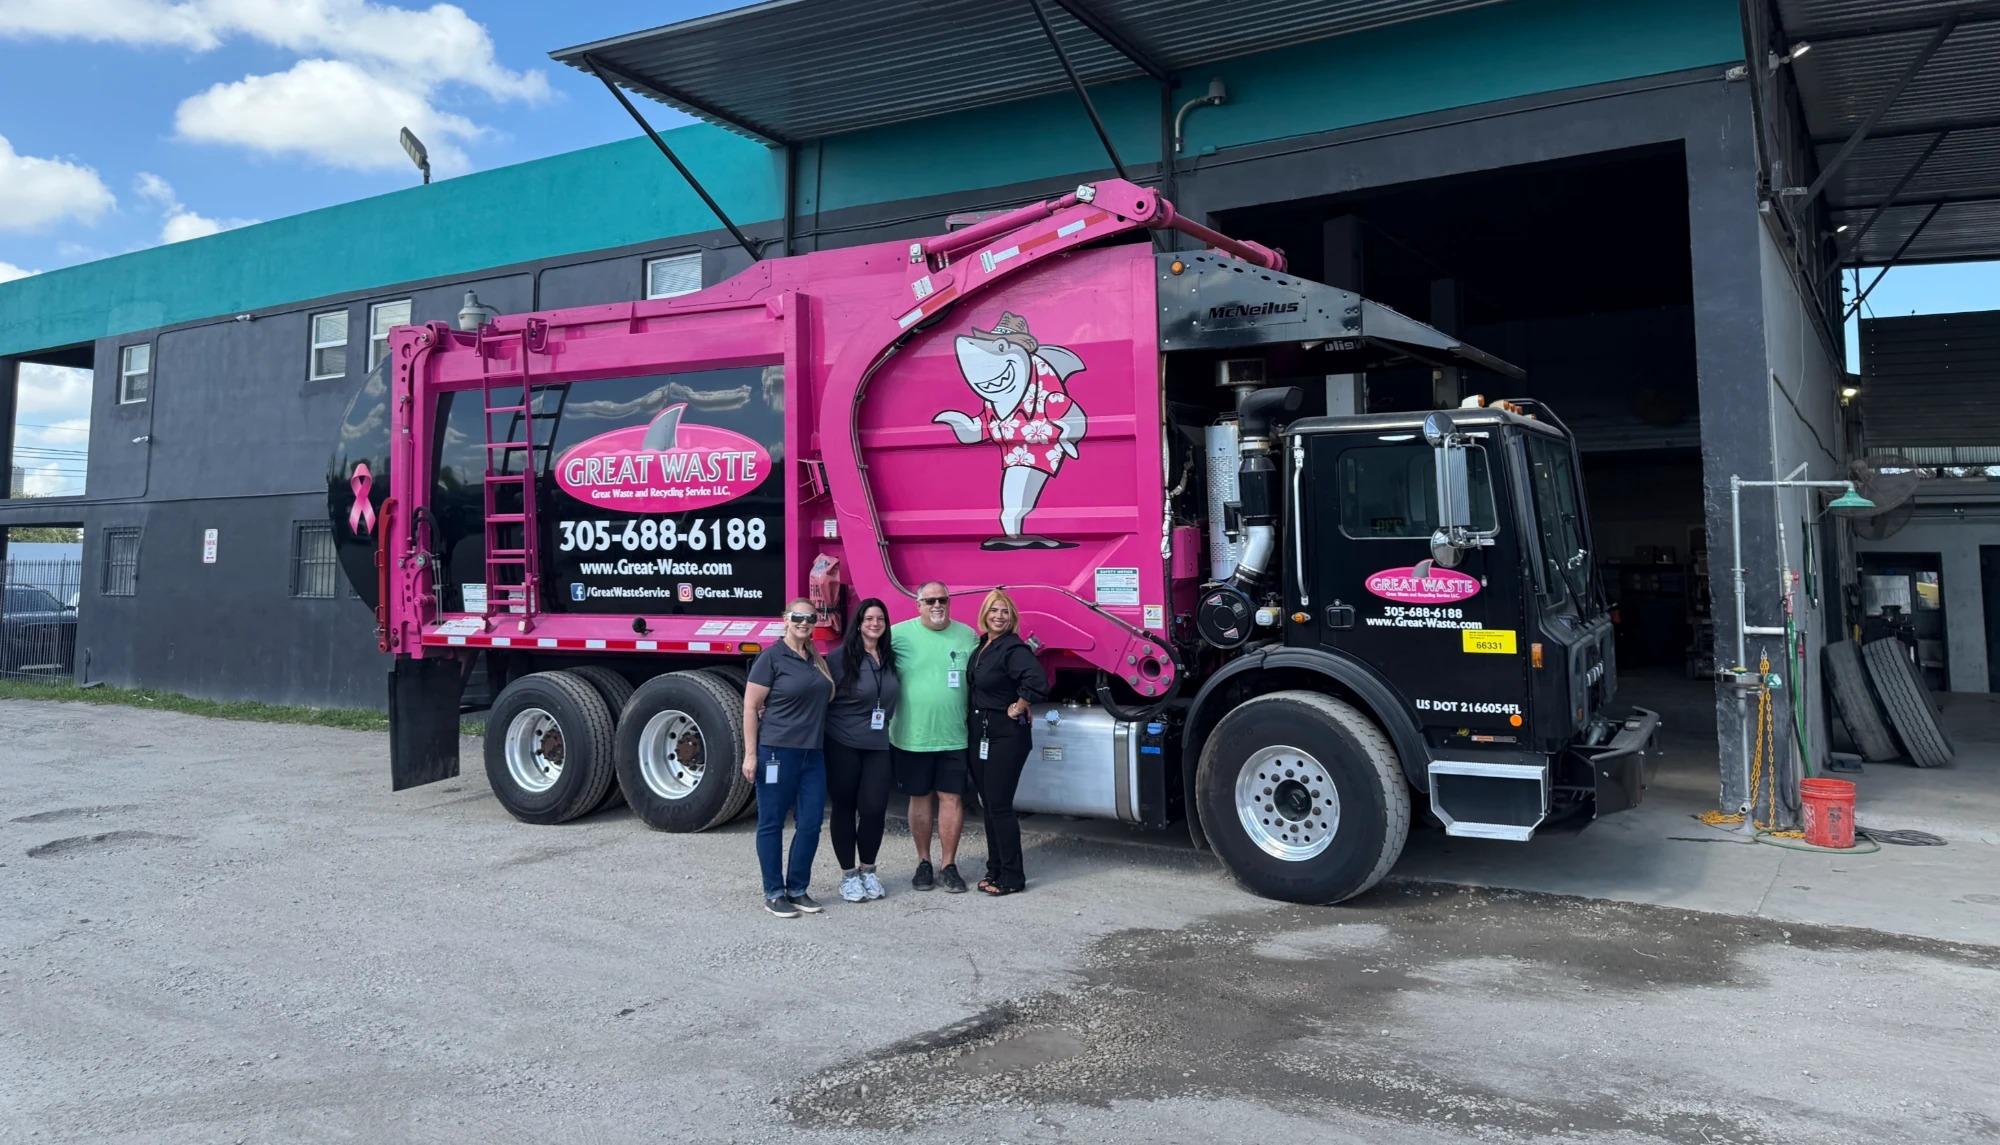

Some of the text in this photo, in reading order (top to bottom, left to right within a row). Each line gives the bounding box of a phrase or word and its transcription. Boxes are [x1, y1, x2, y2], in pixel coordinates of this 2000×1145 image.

[1209, 302, 1299, 319] McNeilus
[565, 451, 758, 487] GREAT WASTE
[592, 485, 731, 499] Great Waste and Recycling Service LLC.
[559, 517, 767, 551] 305-688-6188
[580, 558, 733, 576] www.Great-Waste.com
[587, 586, 671, 598] /GreatWasteService
[695, 588, 763, 599] @Great_Waste
[1370, 578, 1474, 593] GREAT WASTE
[1384, 606, 1463, 619] 305-688-6188
[1366, 617, 1483, 630] www.Great-Waste.com
[1476, 641, 1503, 650] 66331
[1416, 699, 1522, 714] US DOT 2166054FL
